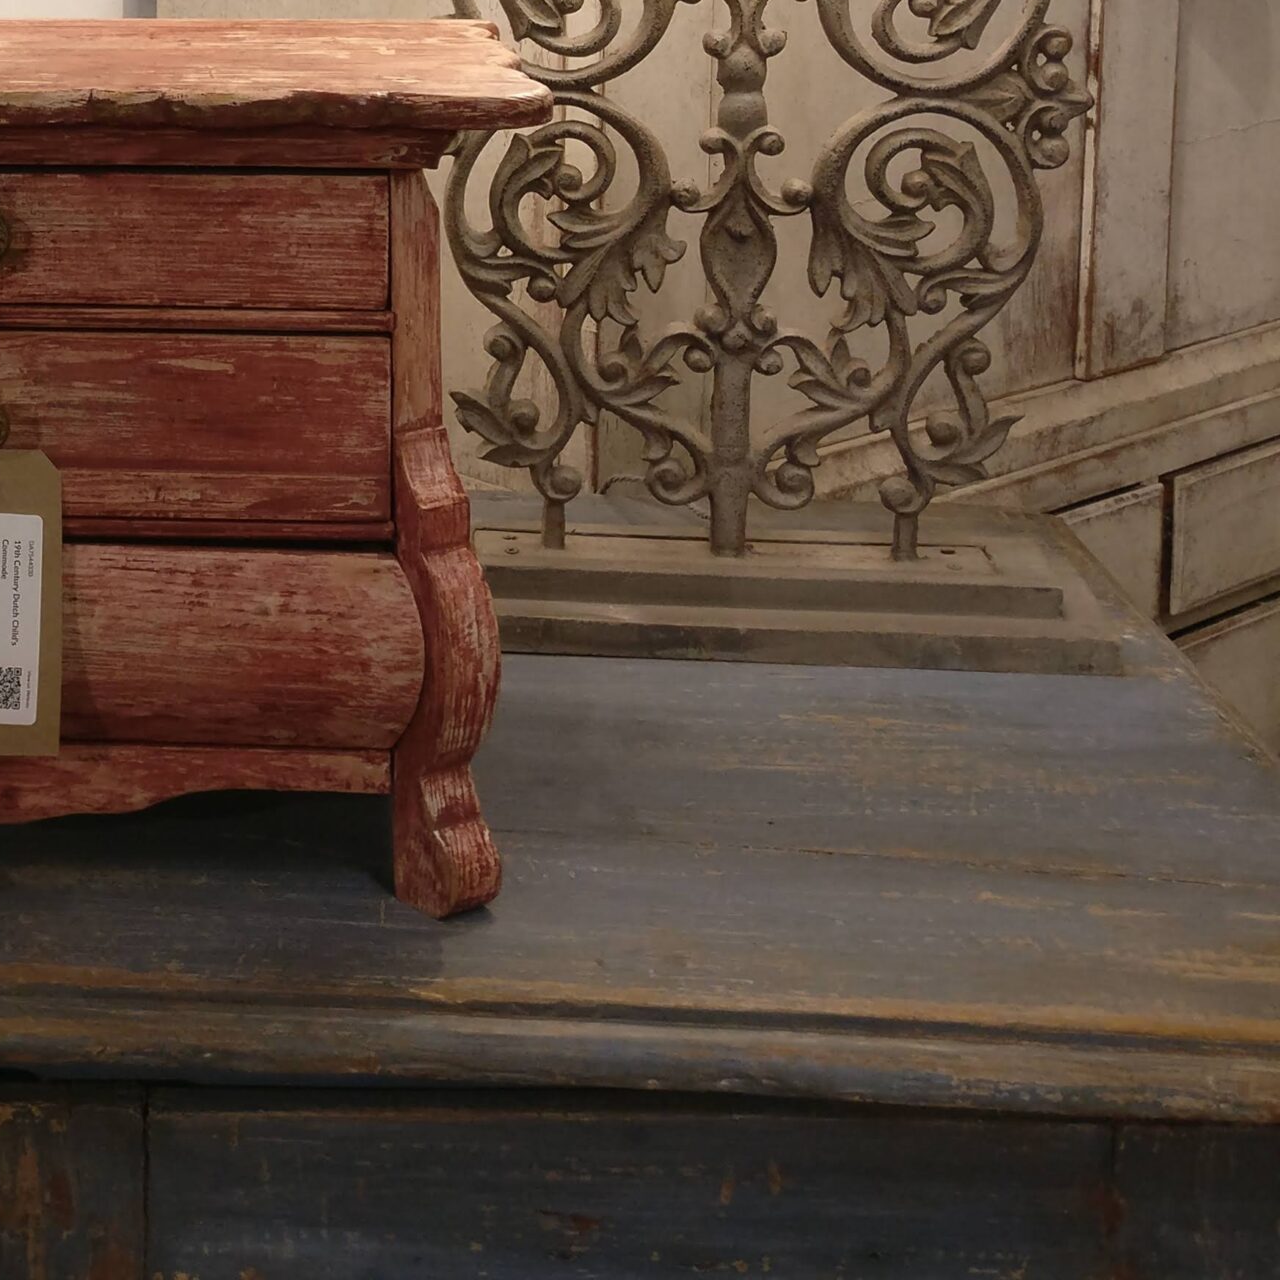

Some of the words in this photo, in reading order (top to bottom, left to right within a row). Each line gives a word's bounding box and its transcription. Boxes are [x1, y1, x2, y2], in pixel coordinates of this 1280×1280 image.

[0, 539, 10, 580] Commode
[14, 540, 22, 559] 19th
[12, 560, 21, 593] Century
[12, 593, 20, 618] Dutch
[11, 619, 20, 647] Child's
